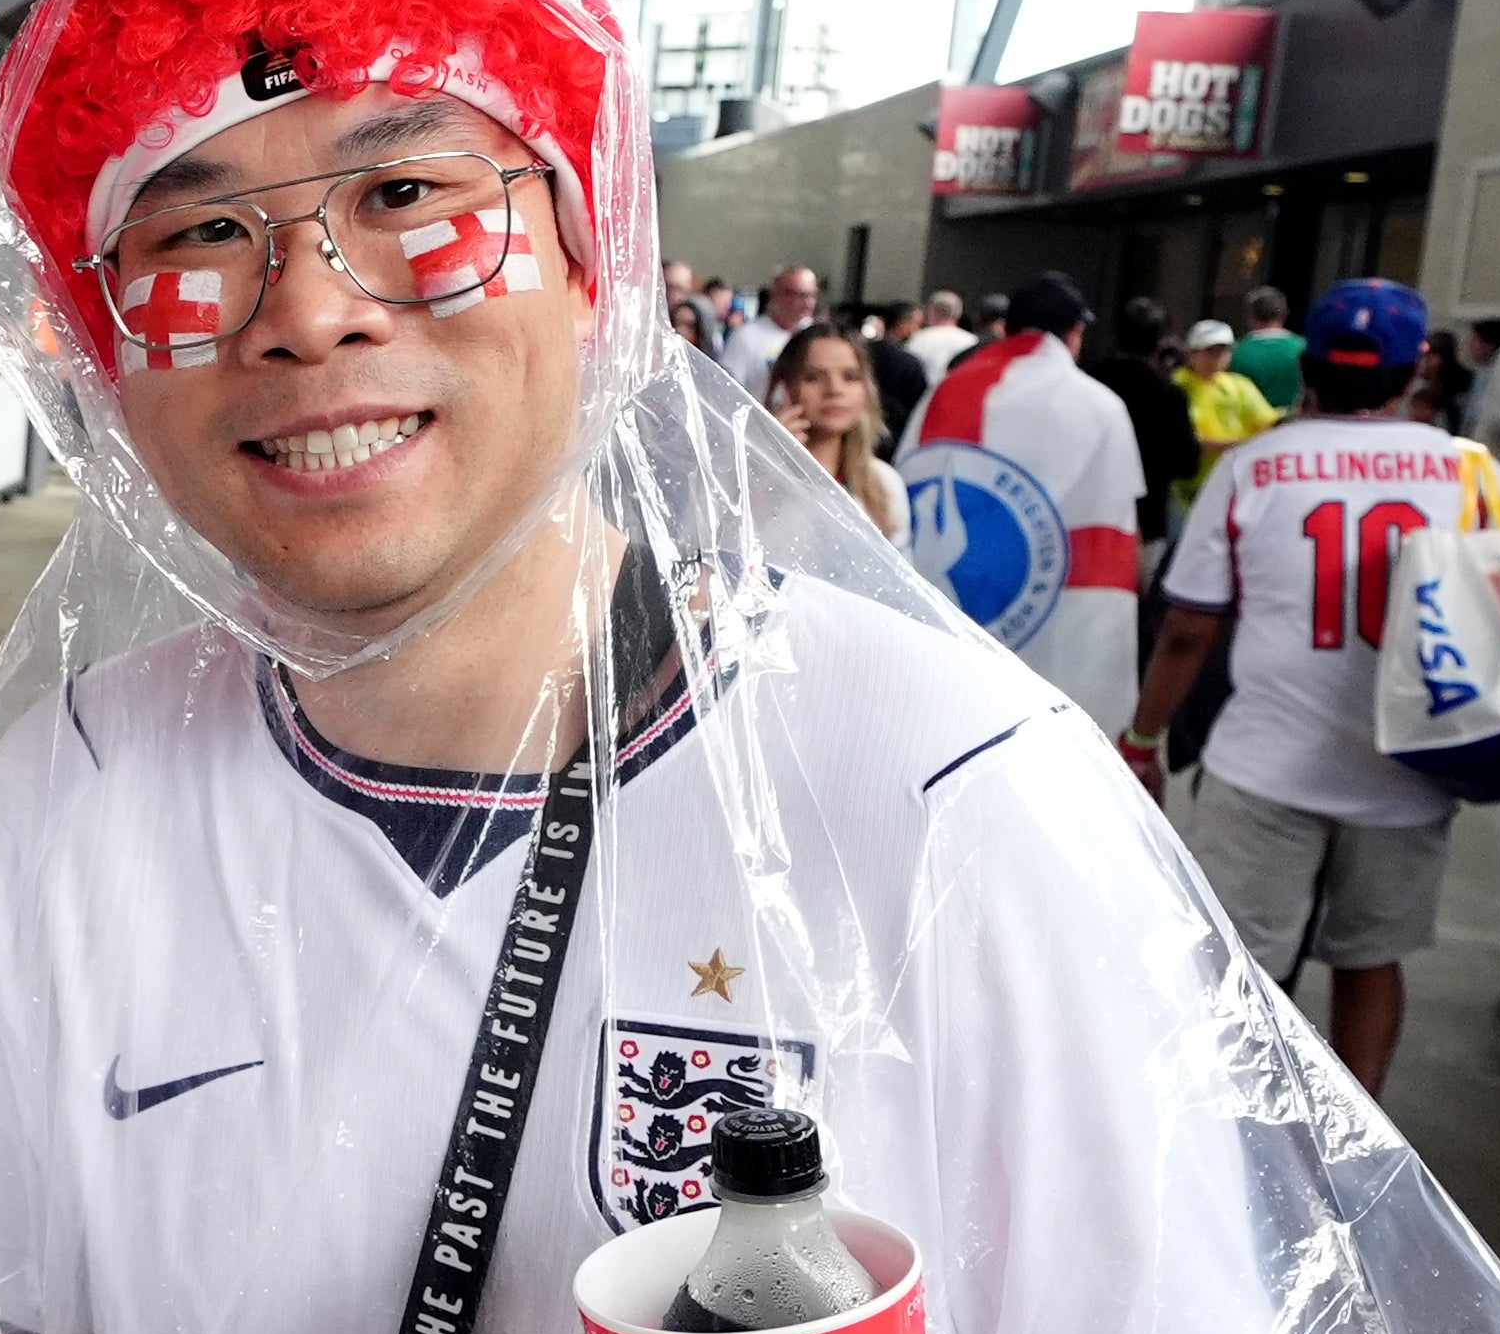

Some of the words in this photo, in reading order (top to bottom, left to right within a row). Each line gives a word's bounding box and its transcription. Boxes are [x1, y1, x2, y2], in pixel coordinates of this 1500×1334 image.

[264, 69, 297, 90] FIFA
[1152, 60, 1240, 101] HOT
[1119, 94, 1233, 136] DOGS
[956, 126, 1021, 154] HOT
[1415, 578, 1482, 718] VISA
[540, 820, 581, 861] IS
[491, 880, 567, 1045] FUTURE
[466, 1062, 521, 1140] THE
[433, 1165, 495, 1273] PAST
